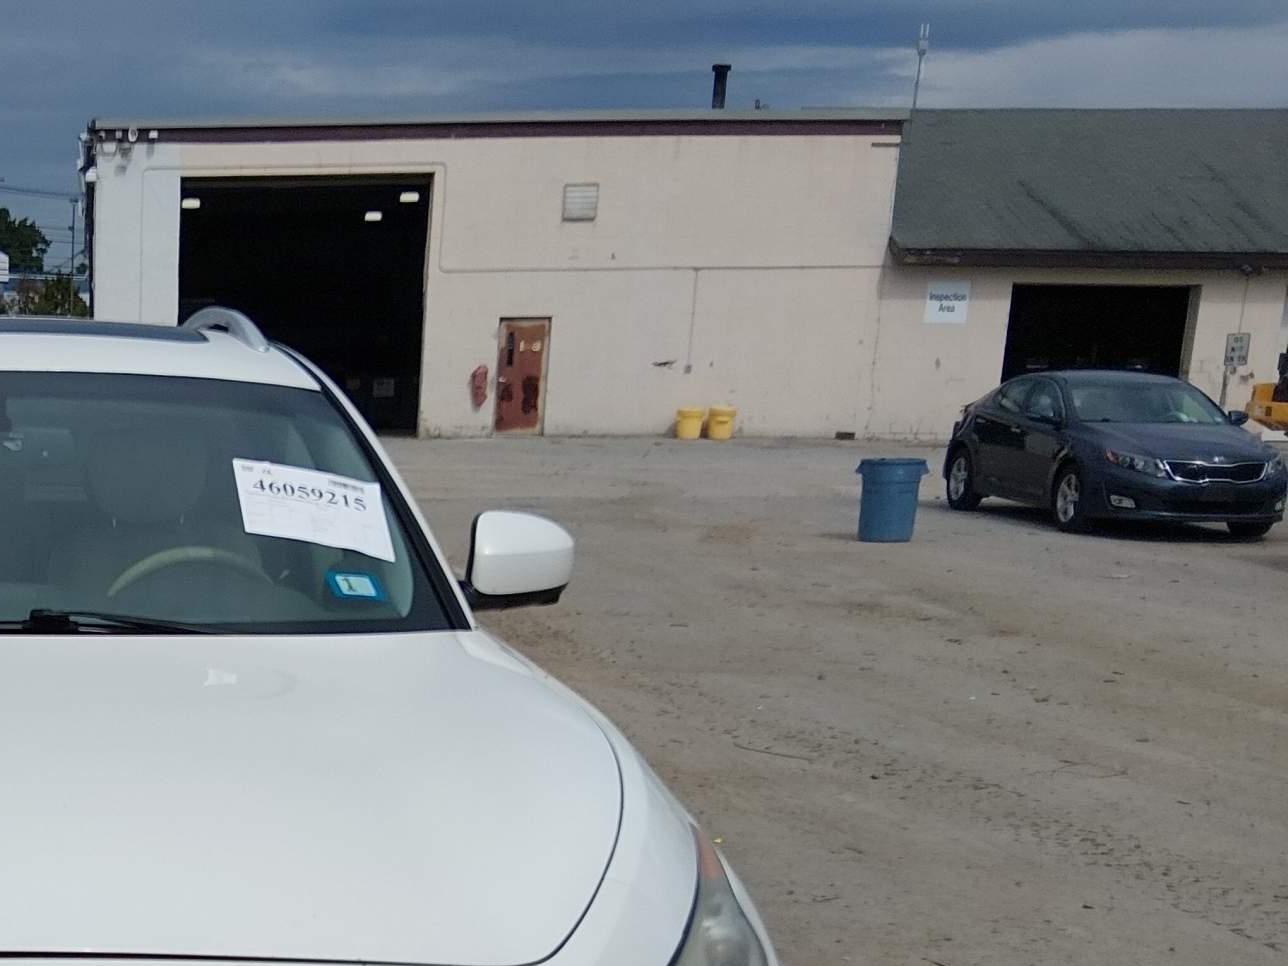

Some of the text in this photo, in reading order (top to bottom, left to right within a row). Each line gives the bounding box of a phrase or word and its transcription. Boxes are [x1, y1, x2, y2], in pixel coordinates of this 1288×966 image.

[929, 290, 968, 302] Inspection
[938, 303, 956, 313] Area
[252, 479, 368, 512] 46059215
